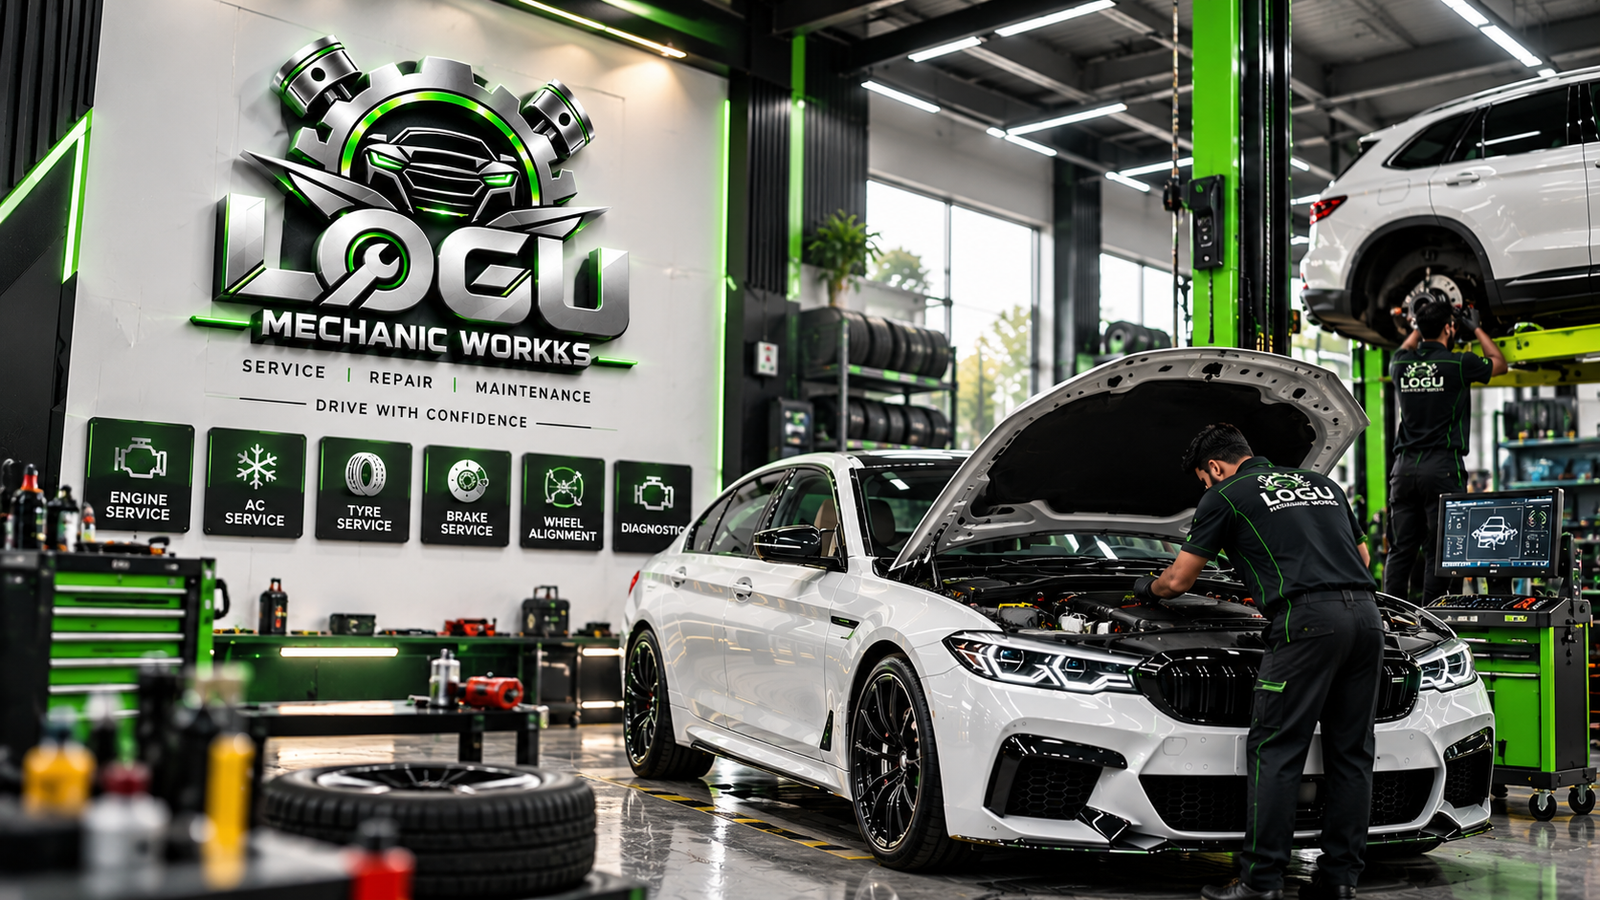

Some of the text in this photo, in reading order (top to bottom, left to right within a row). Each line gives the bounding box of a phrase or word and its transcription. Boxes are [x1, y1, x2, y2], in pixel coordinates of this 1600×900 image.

[213, 192, 630, 339] LOGU
[261, 309, 592, 367] MECHANIC WORKKS
[242, 359, 592, 404] SERVICE REPAIR MAINTENANCE
[1400, 376, 1444, 389] LOGU
[315, 399, 528, 429] DRIVE WITH CONFIDENCE
[109, 491, 168, 507] ENGINE
[1260, 486, 1335, 507] LOGU
[244, 499, 265, 512] AC
[347, 504, 381, 518] TYRE
[105, 506, 170, 521] SERVICE
[224, 512, 285, 527] SERVICE
[446, 510, 488, 524] BRAKE
[336, 517, 392, 532] SERVICE
[440, 523, 493, 537] SERVICE
[543, 516, 584, 529] WHEEL
[528, 528, 597, 542] ALIGNMENT
